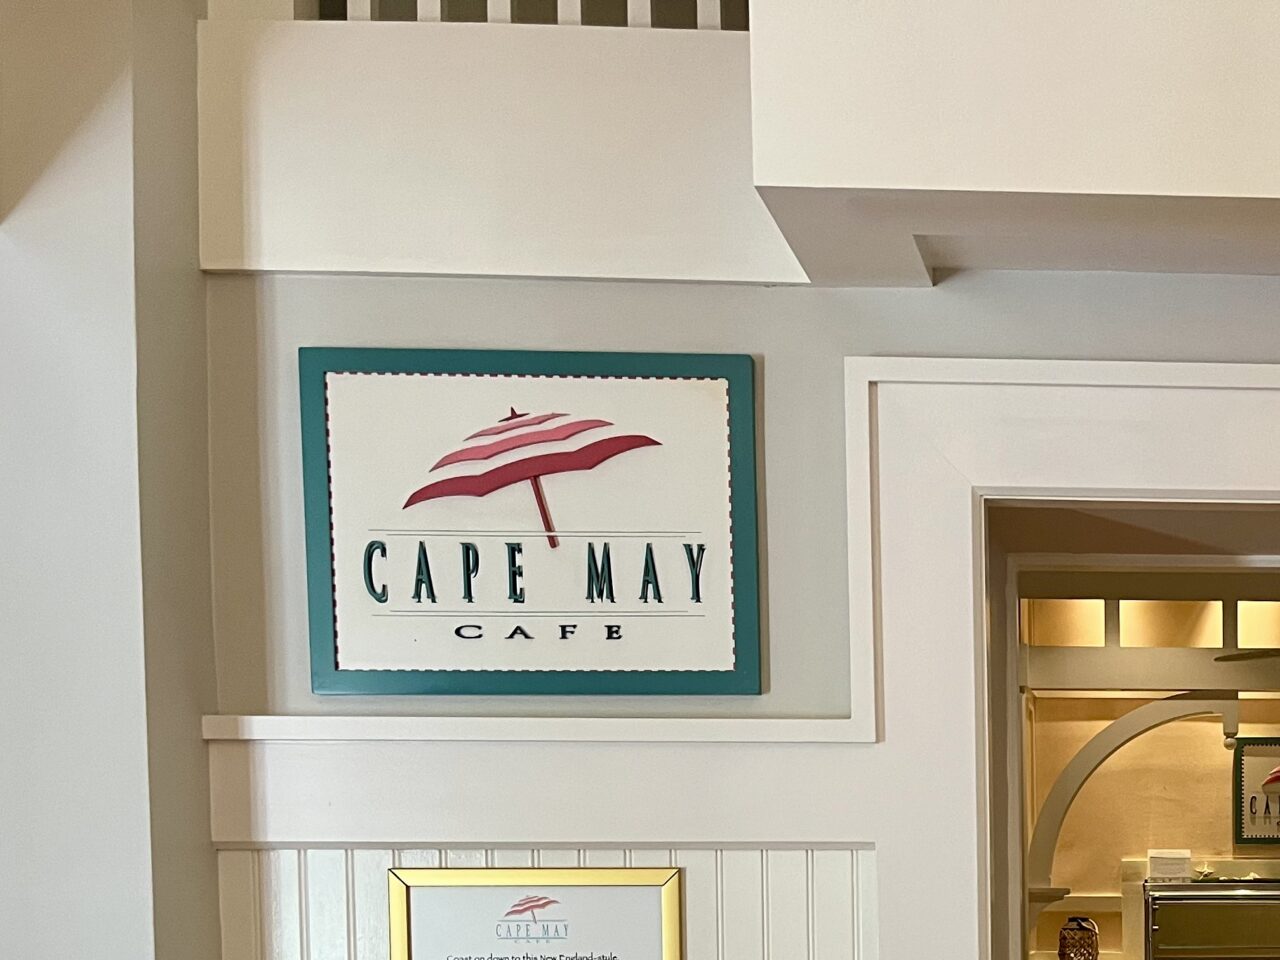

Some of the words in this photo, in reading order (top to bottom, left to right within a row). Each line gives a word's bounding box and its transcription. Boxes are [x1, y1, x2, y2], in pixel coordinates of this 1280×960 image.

[363, 540, 525, 604] CAPE
[585, 540, 705, 604] MAY
[454, 624, 623, 640] CAFE
[495, 923, 531, 937] CAPE
[541, 923, 569, 937] MAY
